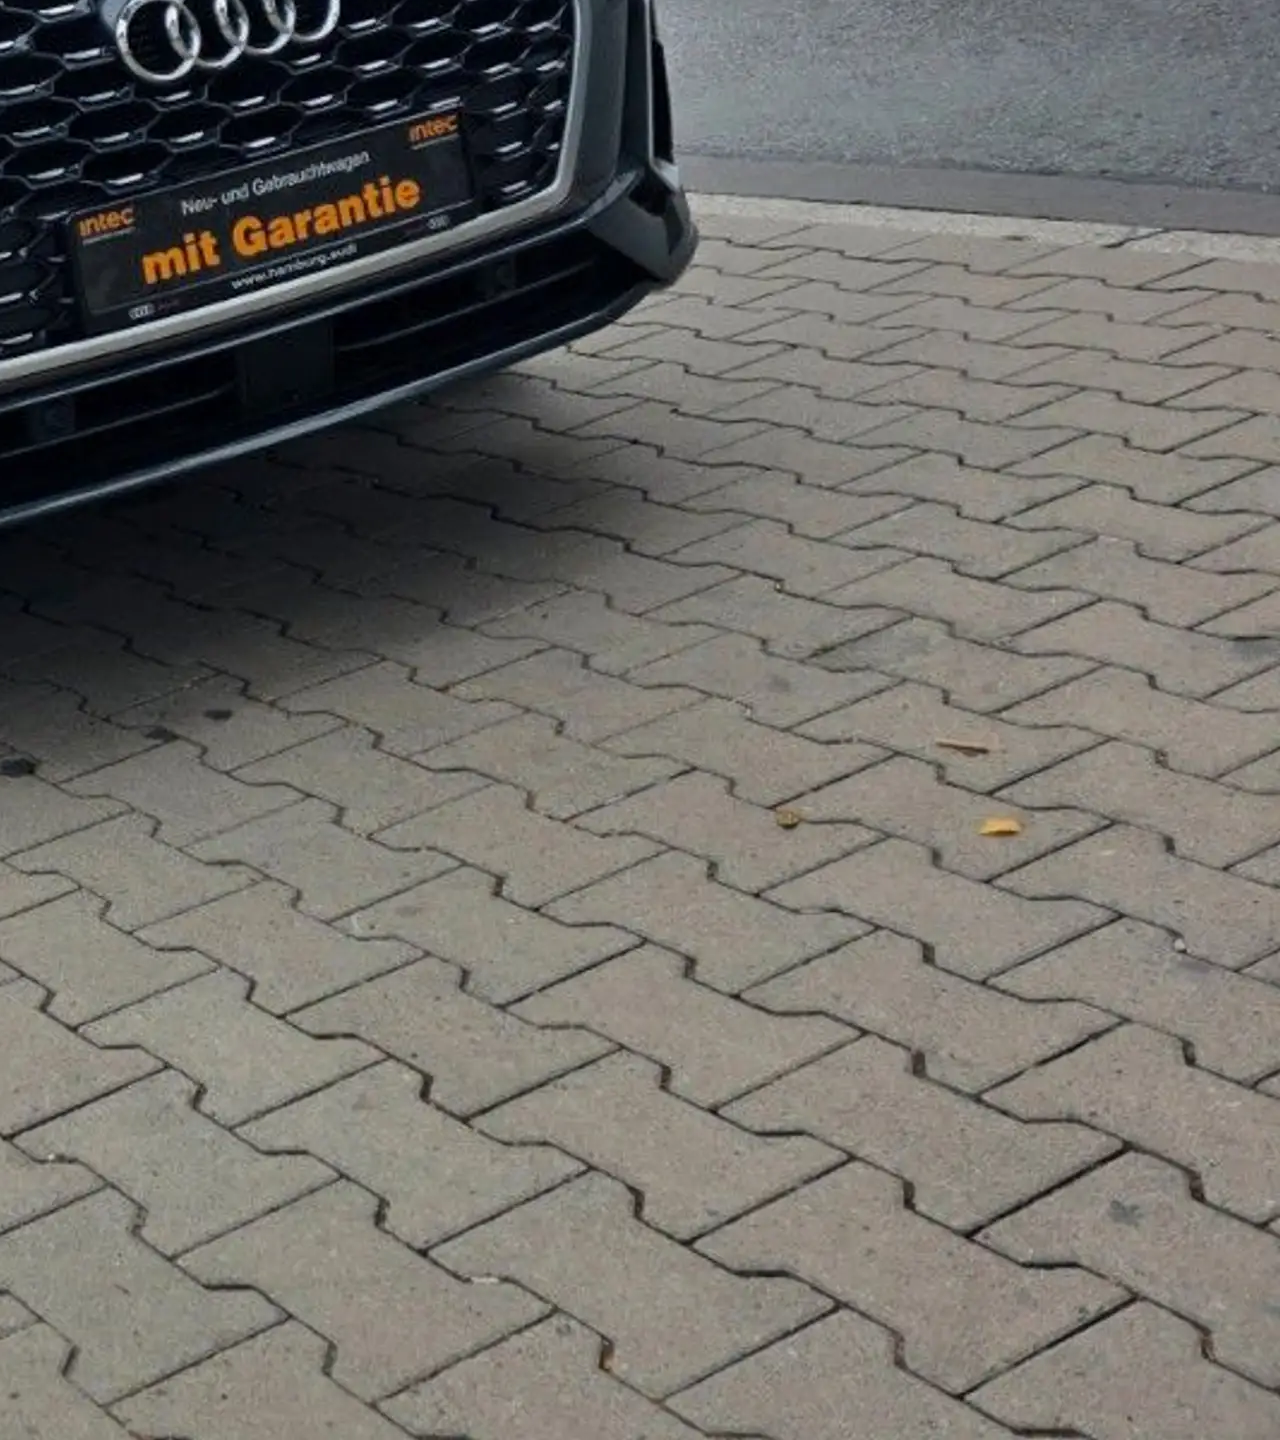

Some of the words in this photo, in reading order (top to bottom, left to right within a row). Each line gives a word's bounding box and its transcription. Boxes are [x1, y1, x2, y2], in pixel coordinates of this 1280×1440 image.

[409, 114, 458, 143] intec
[181, 195, 218, 216] Neu-
[221, 184, 250, 205] und
[252, 149, 370, 196] Gebrauchtwagen
[77, 203, 134, 237] intec
[142, 226, 220, 284] mit
[231, 175, 421, 257] Garantie
